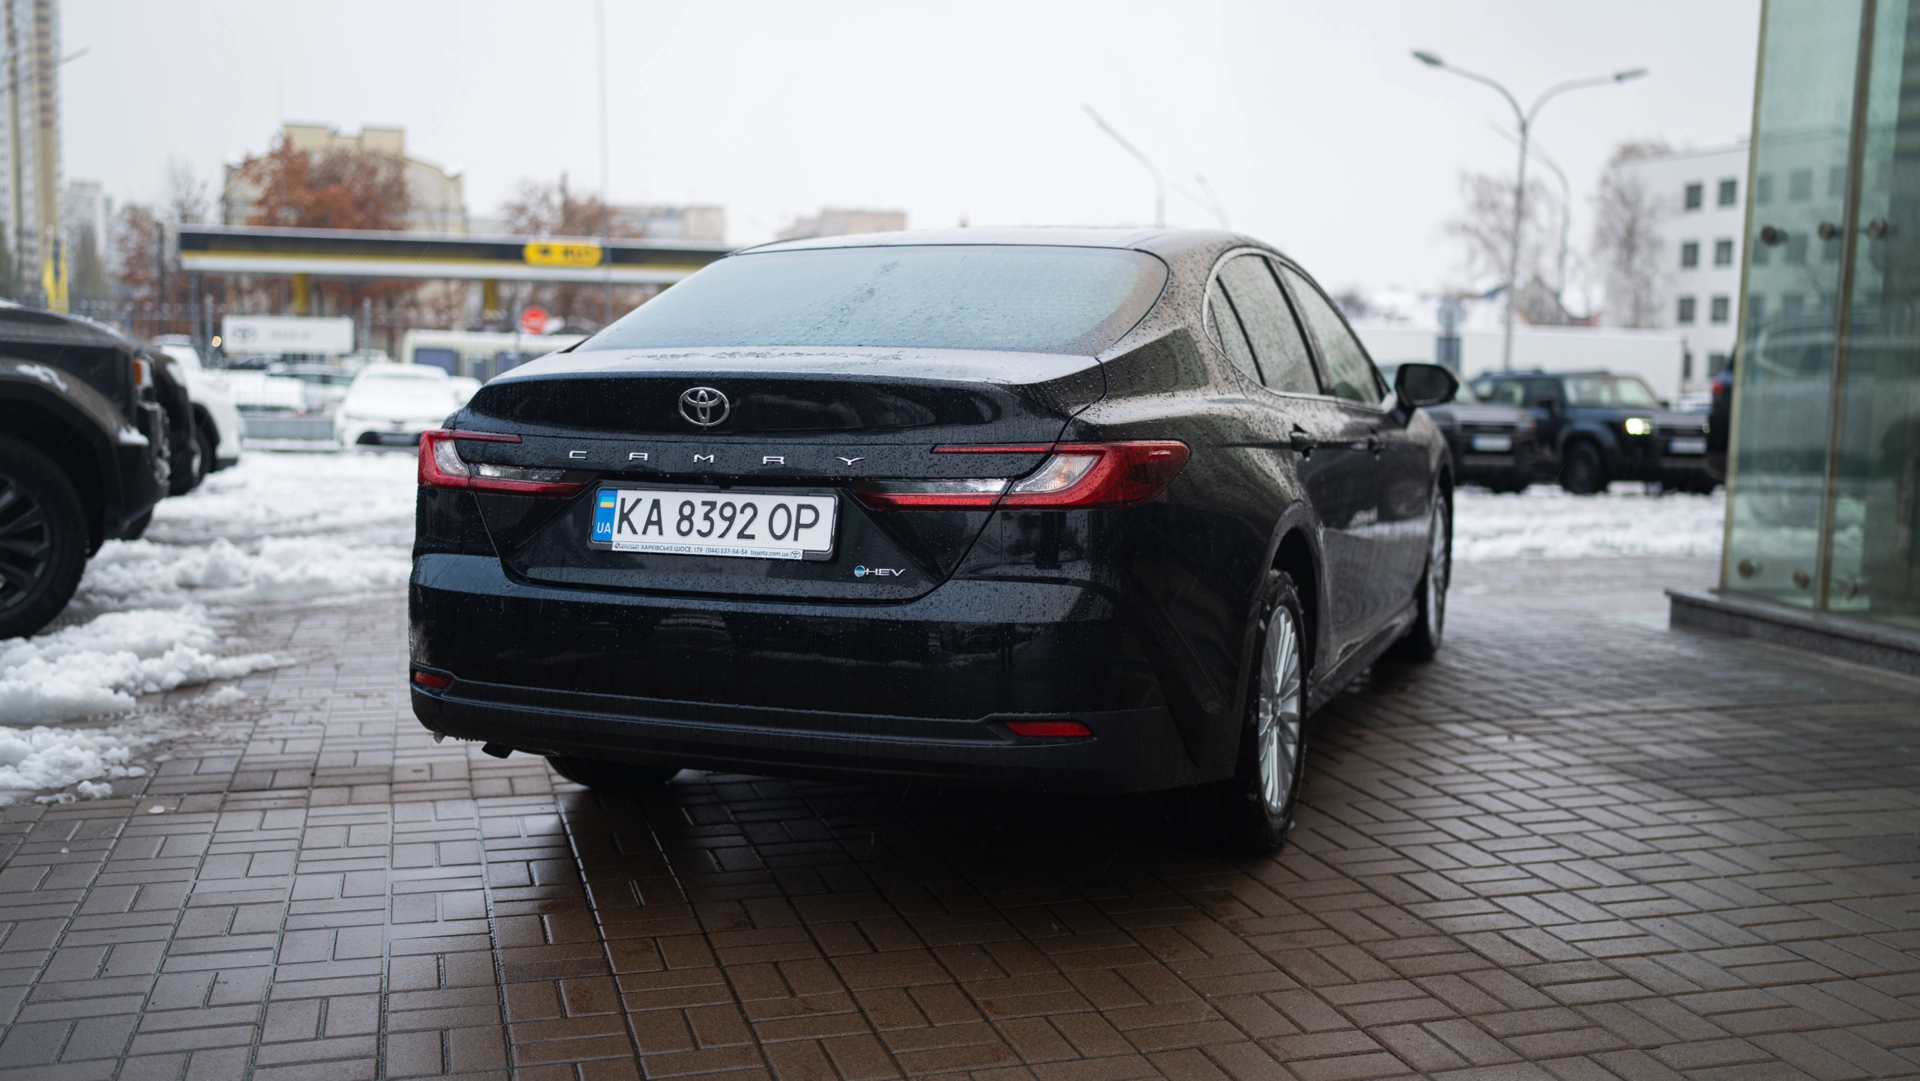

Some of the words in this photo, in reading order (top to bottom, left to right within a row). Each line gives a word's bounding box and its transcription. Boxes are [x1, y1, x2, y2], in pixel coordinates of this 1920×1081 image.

[568, 450, 865, 466] CAMRY
[616, 497, 664, 536] KA
[676, 500, 759, 540] 8392
[768, 503, 821, 542] OP
[596, 522, 612, 534] UA
[865, 568, 906, 577] HEV
